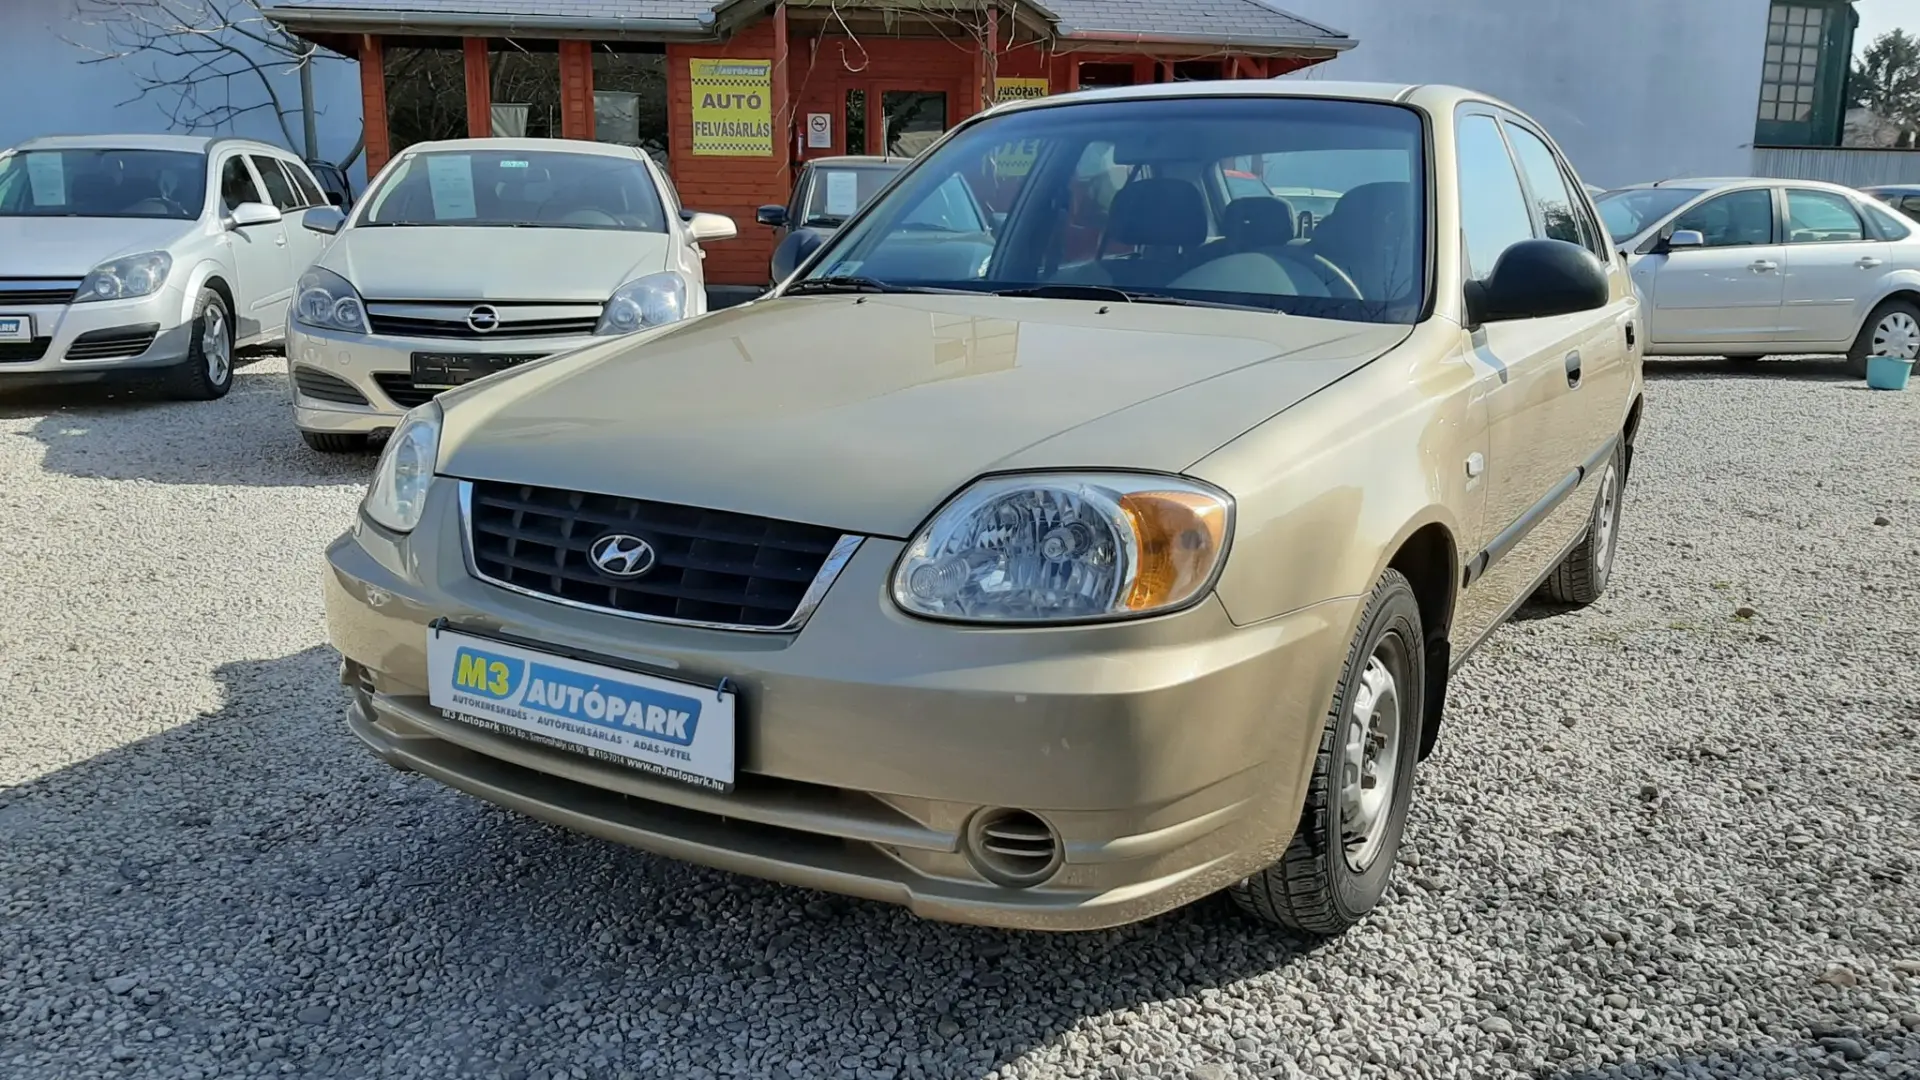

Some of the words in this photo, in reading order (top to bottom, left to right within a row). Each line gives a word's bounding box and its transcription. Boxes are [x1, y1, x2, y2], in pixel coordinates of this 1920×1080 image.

[702, 90, 762, 109] AUTÓ
[694, 118, 770, 138] FELVÁSÁRLÁS
[457, 653, 510, 696] M3
[527, 678, 691, 740] AUTÓPARK
[441, 708, 456, 720] M3
[626, 758, 725, 792] www.m3autopark.hu
